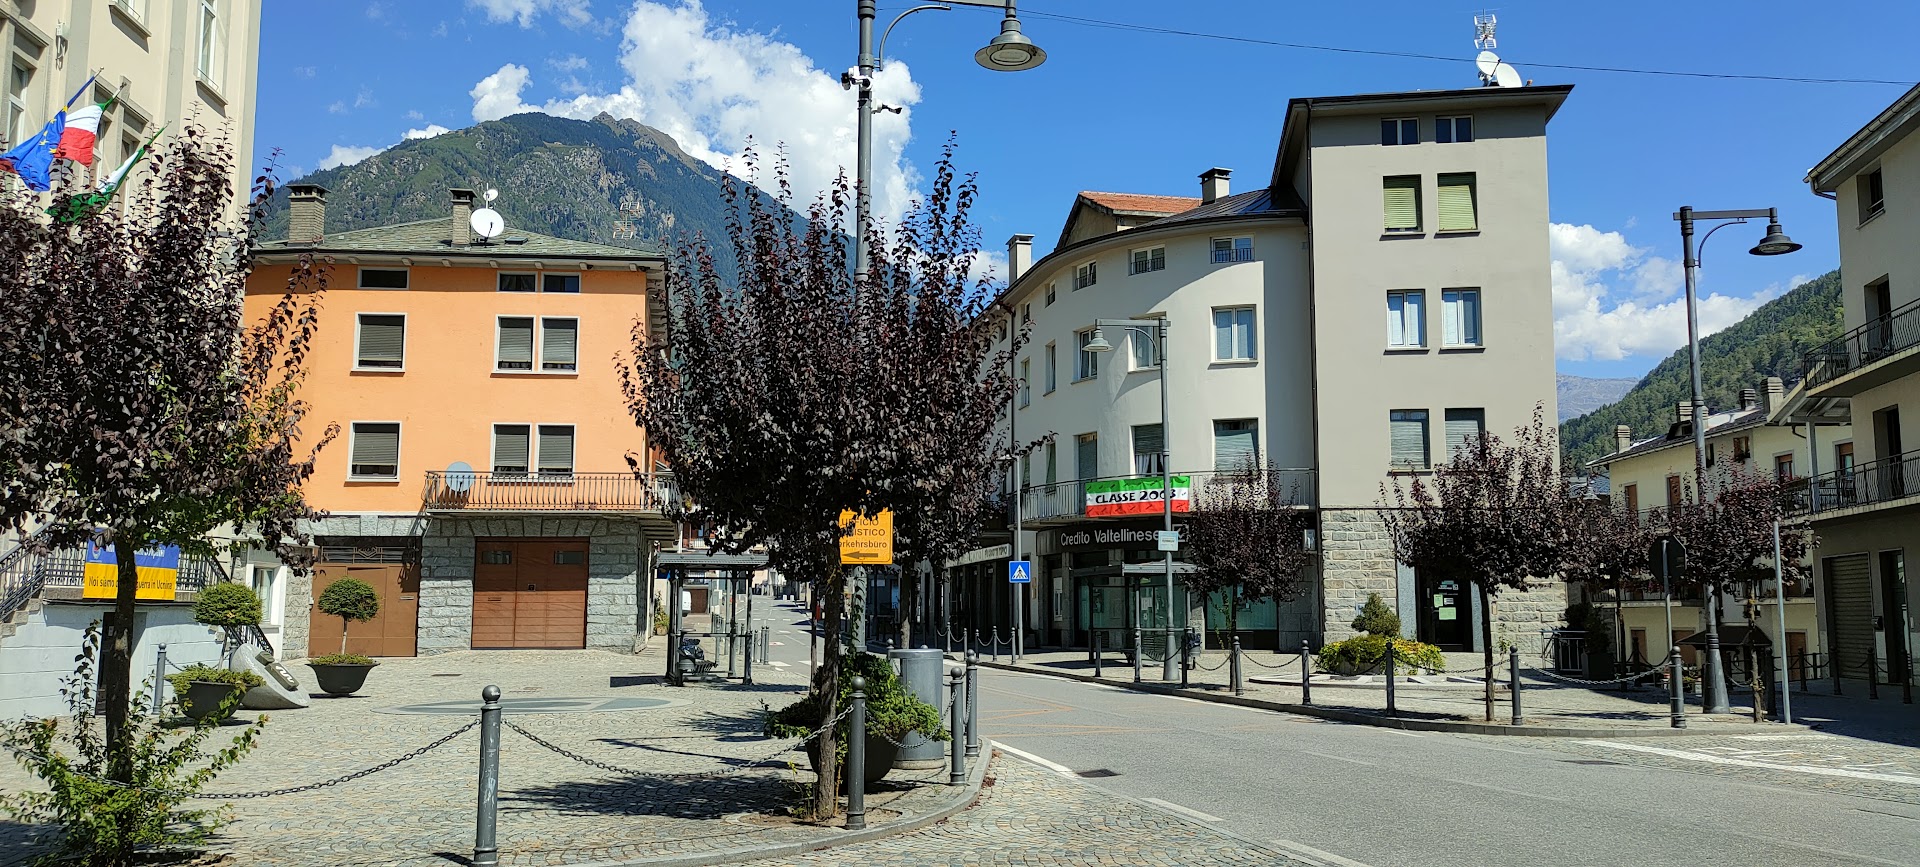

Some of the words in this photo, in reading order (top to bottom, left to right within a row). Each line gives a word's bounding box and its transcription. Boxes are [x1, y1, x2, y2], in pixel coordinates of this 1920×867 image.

[1096, 492, 1136, 504] CLASSE
[854, 528, 886, 537] ISTICO
[1060, 531, 1091, 546] Credito
[1094, 528, 1159, 543] Valtellinese
[839, 540, 888, 548] erkehrsbüro
[88, 576, 99, 587] Noi
[100, 576, 115, 588] siamo
